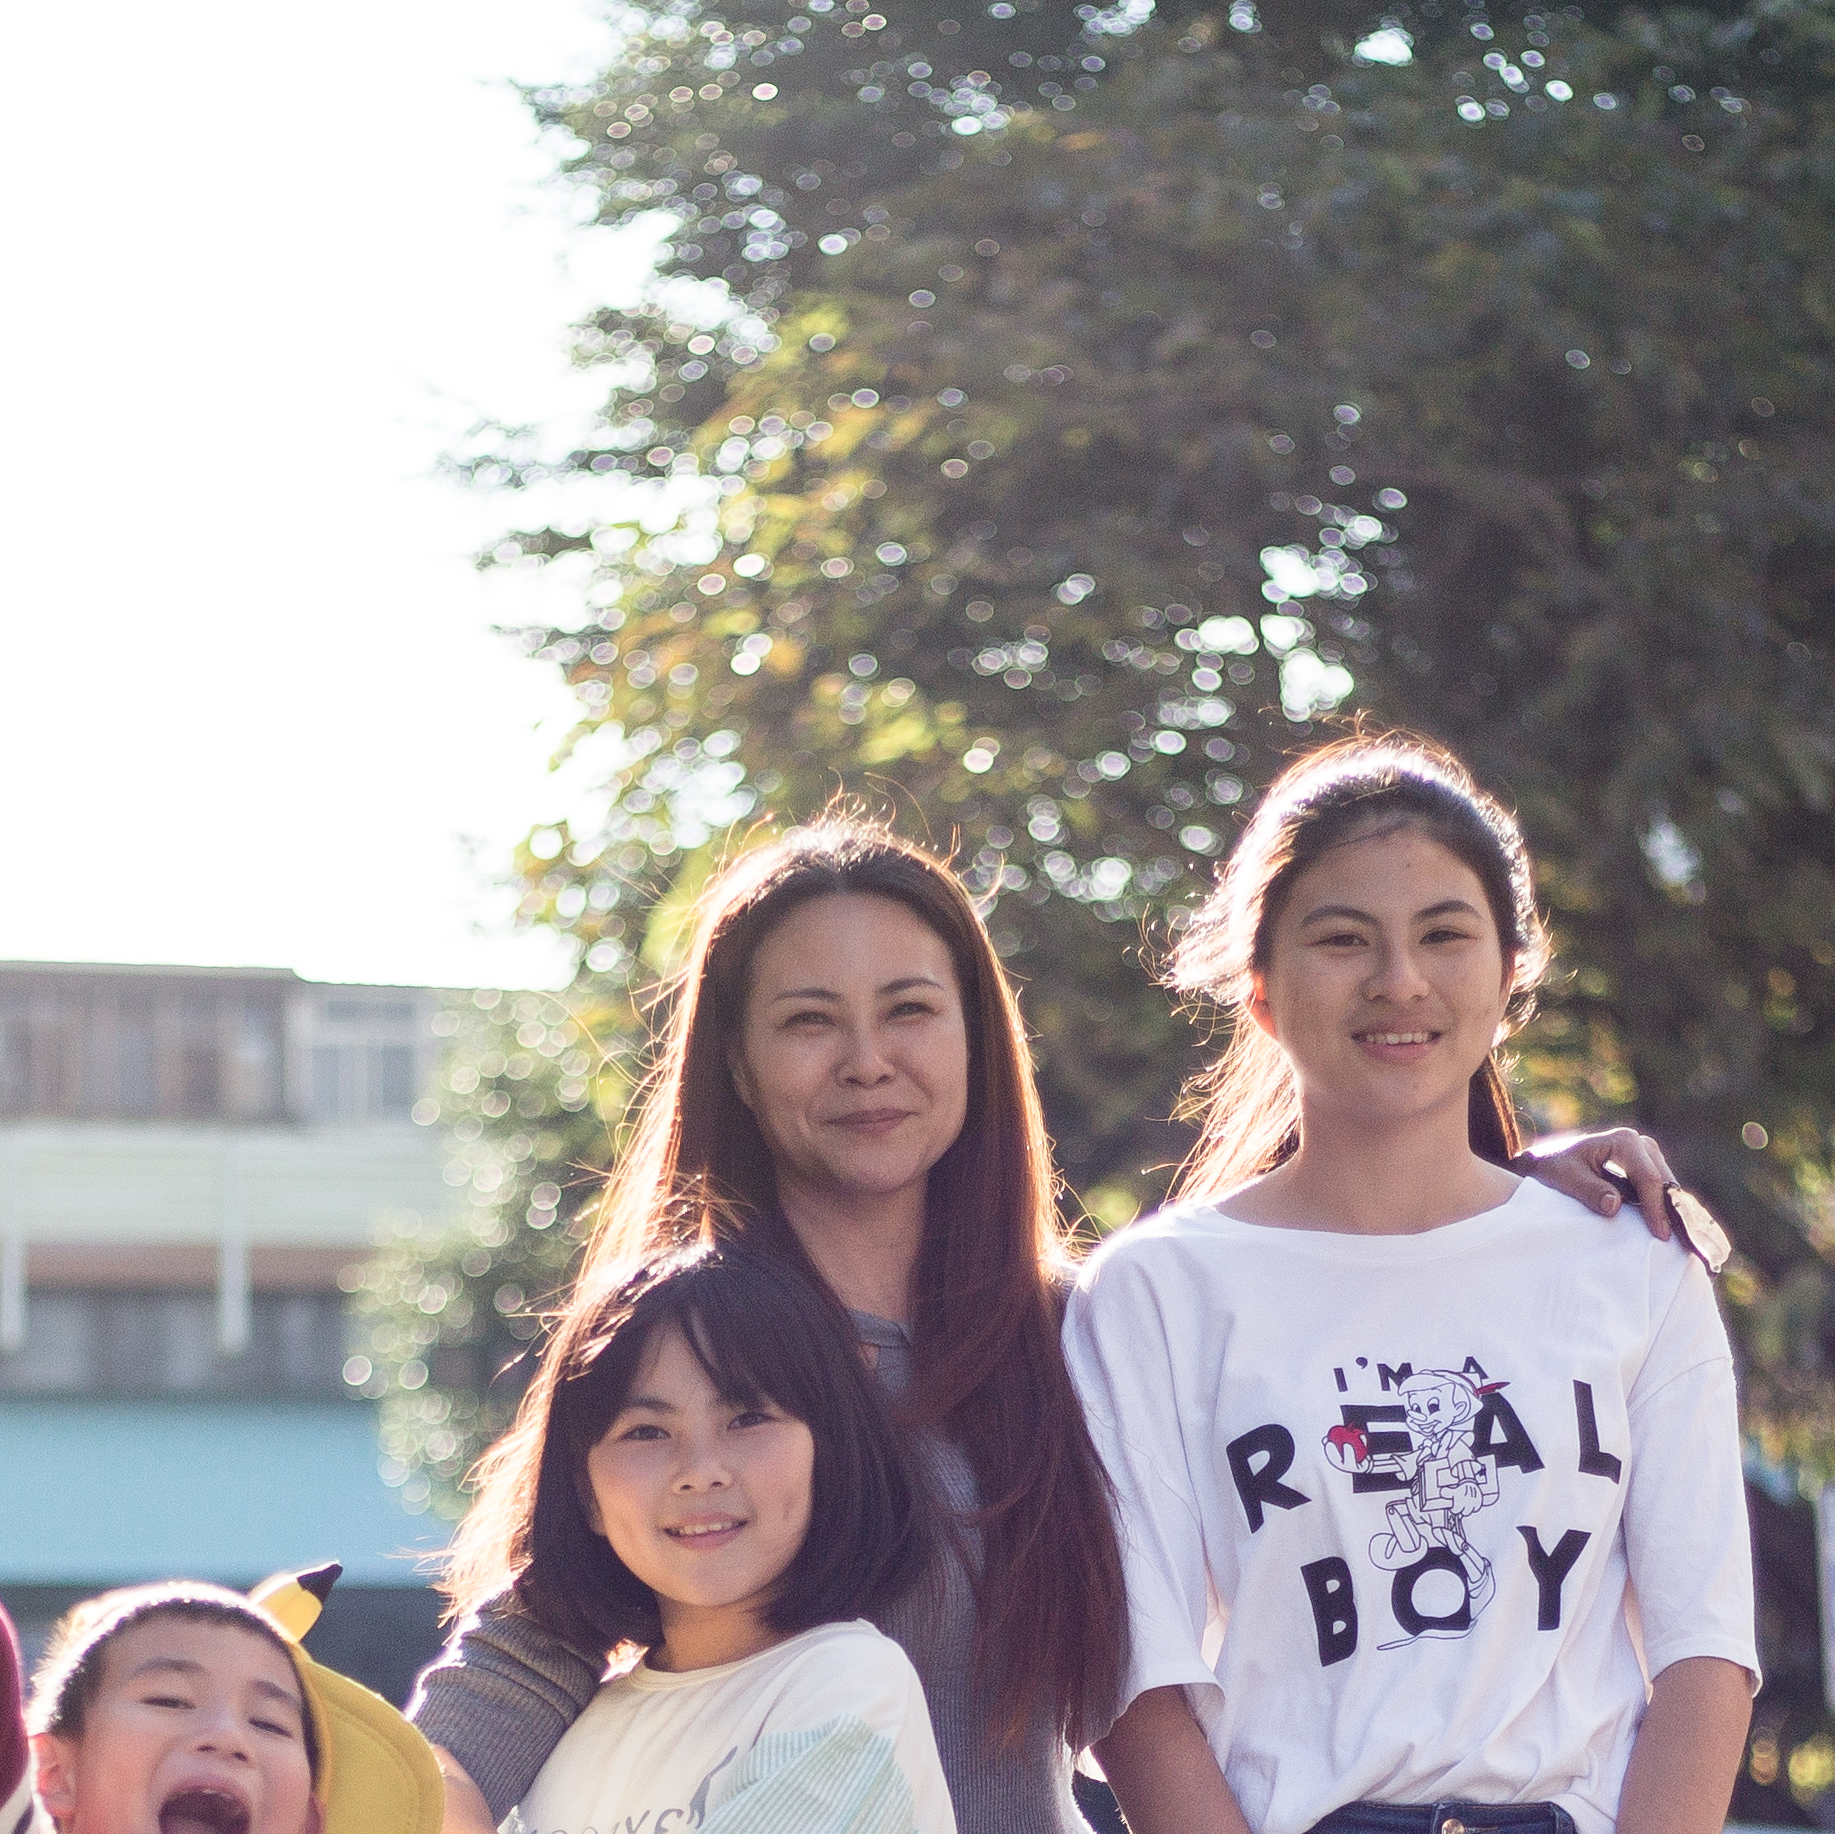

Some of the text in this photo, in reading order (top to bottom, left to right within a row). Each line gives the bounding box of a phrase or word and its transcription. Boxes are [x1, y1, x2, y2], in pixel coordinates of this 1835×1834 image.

[1332, 1356, 1413, 1393] I'M
[1226, 1379, 1624, 1534] REAL
[1300, 1525, 1593, 1668] BOY
